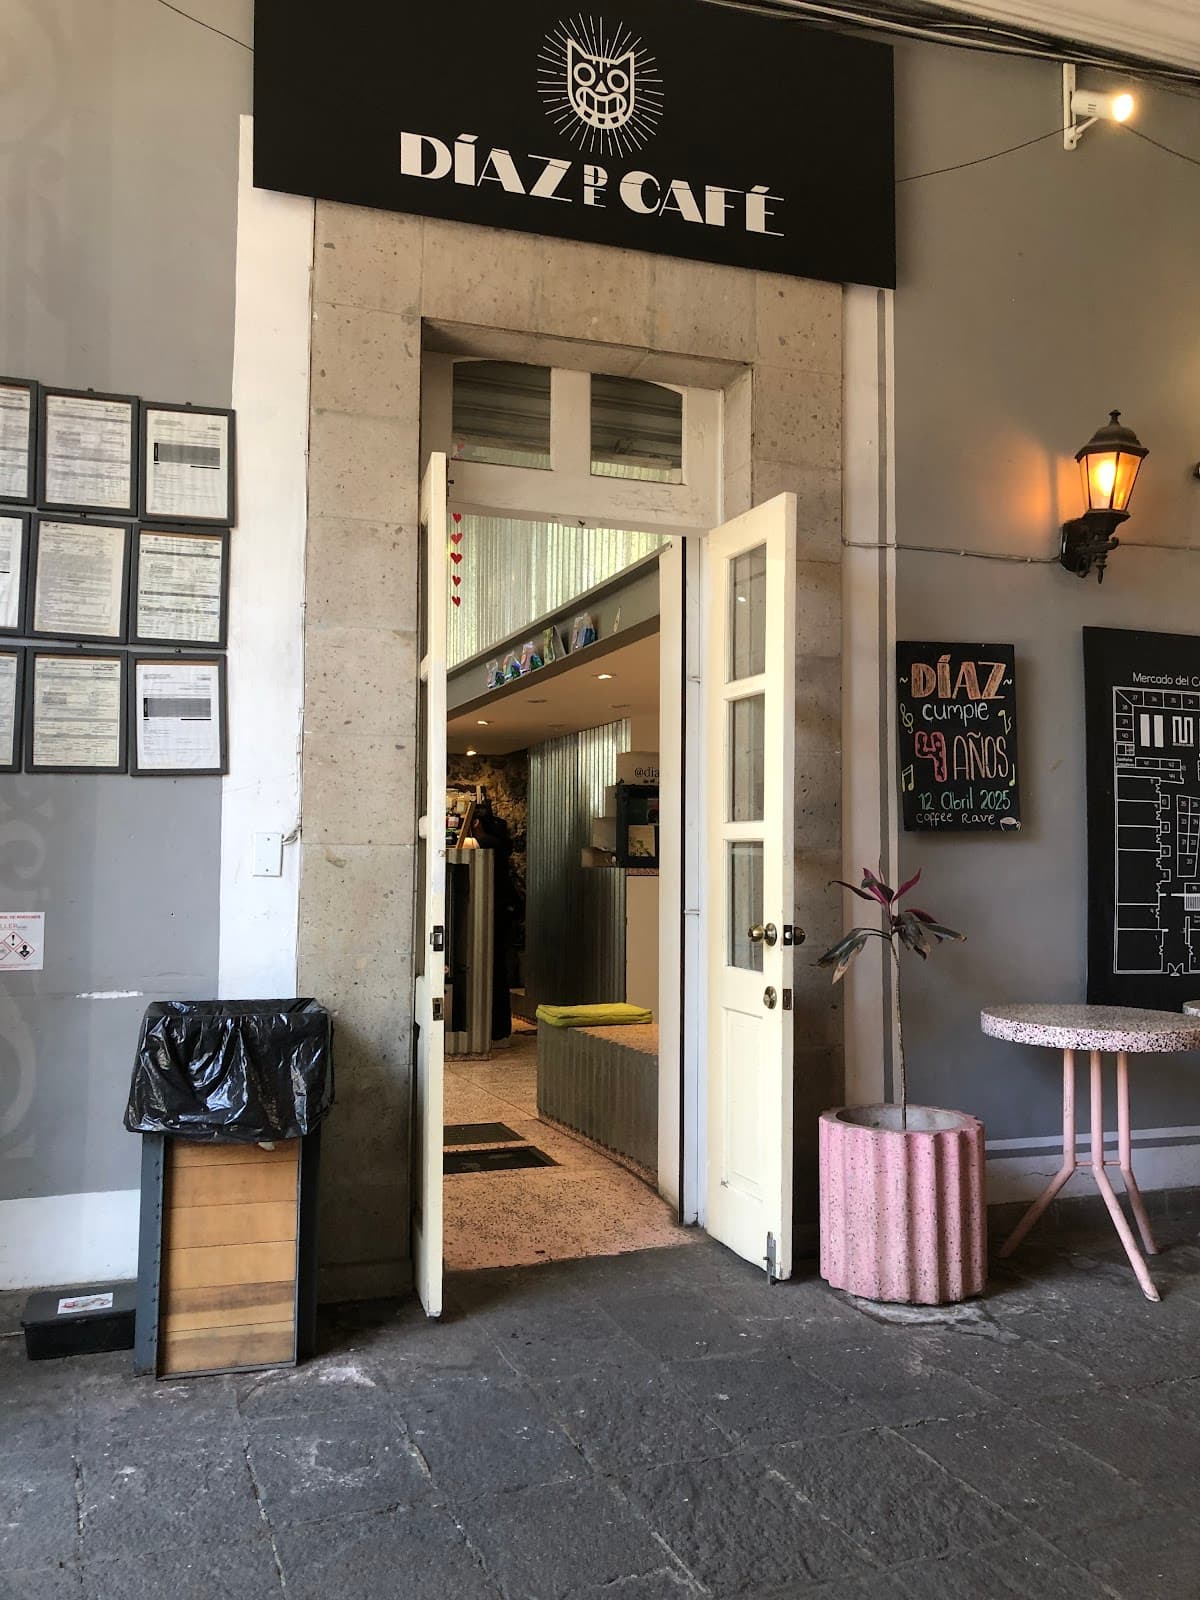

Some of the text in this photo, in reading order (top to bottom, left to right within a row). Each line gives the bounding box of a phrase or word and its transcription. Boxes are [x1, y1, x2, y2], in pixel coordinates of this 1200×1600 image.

[400, 131, 573, 202] DÍAZ
[618, 170, 785, 237] CAFÉ
[911, 654, 1007, 700] DÍAZ
[1132, 671, 1200, 687] Mercado del C
[922, 702, 990, 728] cumple
[953, 731, 1009, 780] AÑOS
[918, 791, 935, 810] 12
[980, 789, 1011, 810] 2025
